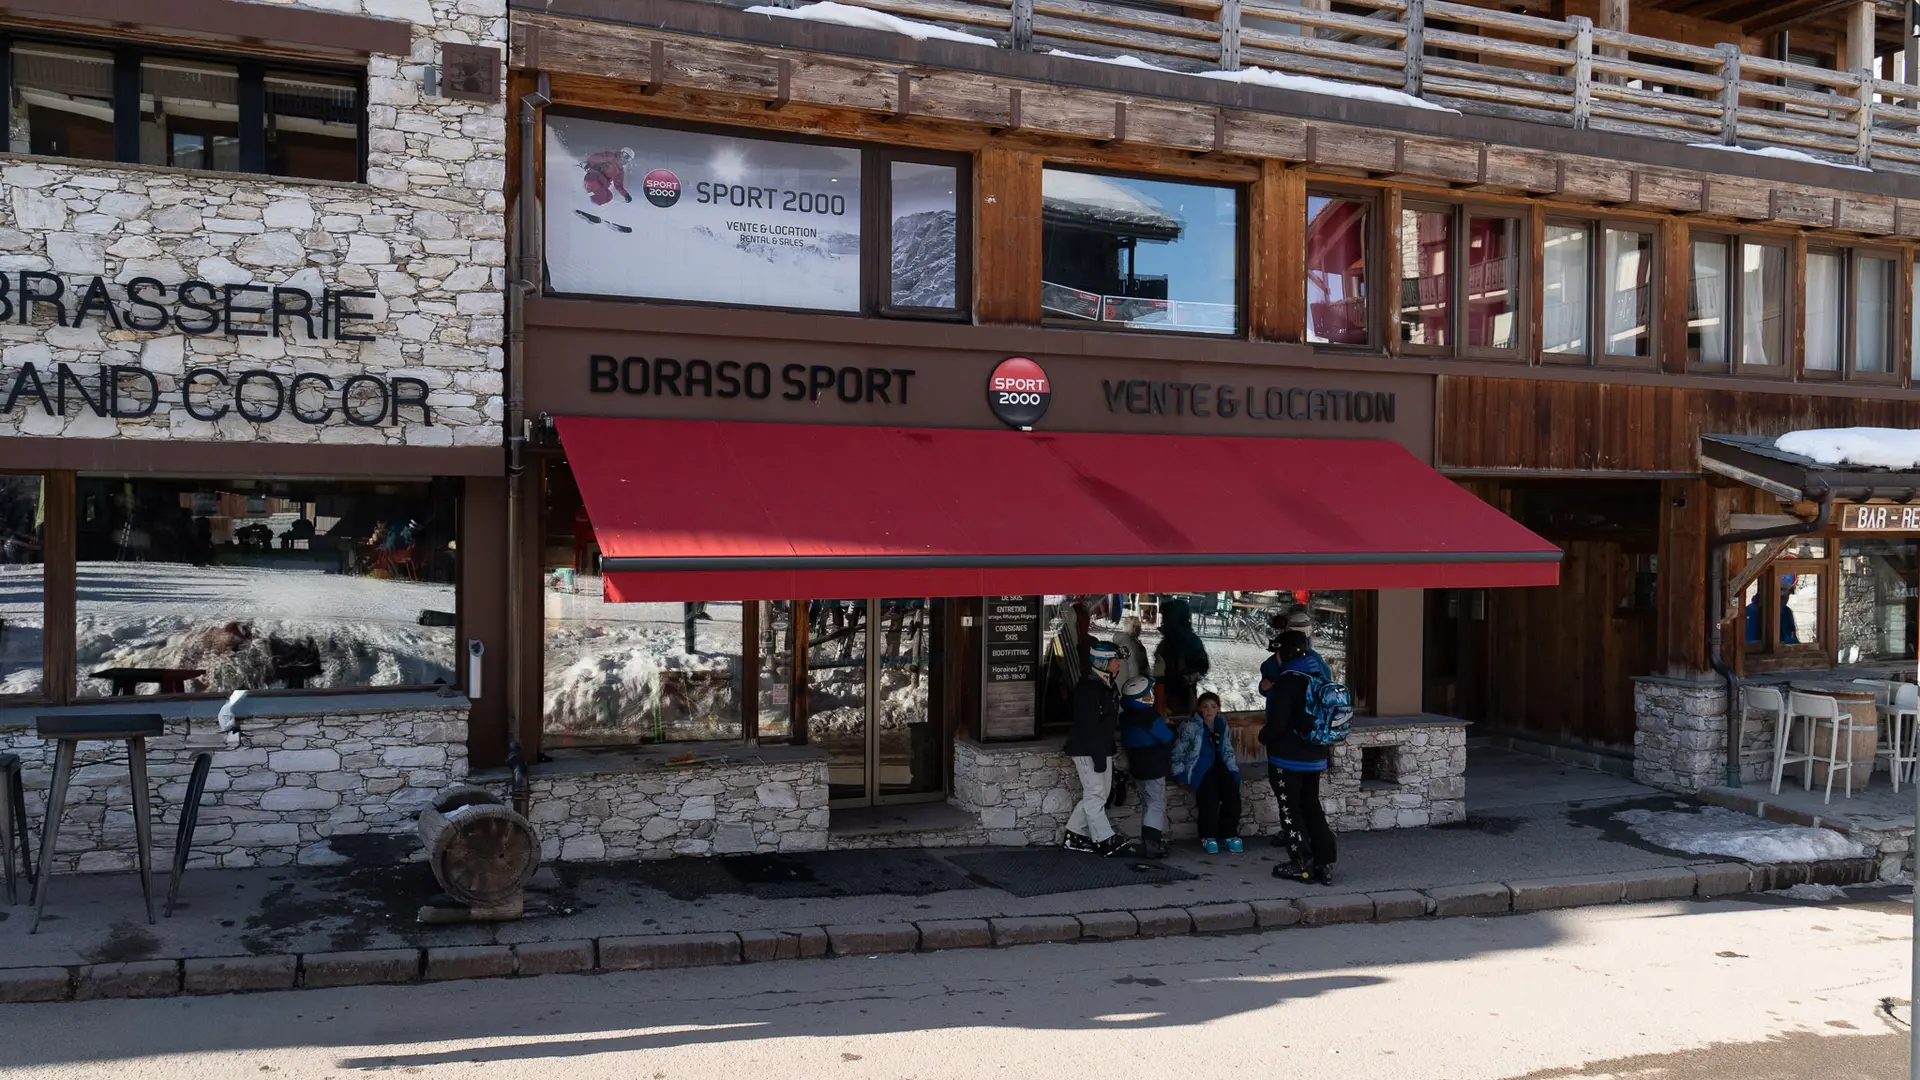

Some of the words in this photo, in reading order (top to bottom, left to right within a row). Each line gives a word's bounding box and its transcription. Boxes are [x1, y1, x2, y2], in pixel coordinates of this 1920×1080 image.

[646, 179, 678, 190] SPORT
[649, 188, 675, 198] 2000
[696, 181, 778, 210] SPORT
[783, 190, 846, 216] 2000
[726, 220, 759, 234] VENTE
[760, 224, 767, 234] &
[768, 224, 817, 238] LOCATION
[740, 234, 772, 245] RENTAL
[779, 238, 804, 247] SALES
[589, 354, 772, 399] BORASO
[781, 363, 916, 405] SPORT
[995, 377, 1045, 391] SPORT
[0, 361, 160, 419] AND
[182, 368, 434, 428] COCOR
[999, 393, 1041, 405] 2000
[1103, 379, 1211, 417] VENTE
[1218, 385, 1237, 418] &
[1247, 386, 1395, 423] LOCATION
[1857, 506, 1887, 529] BAR
[1901, 506, 1920, 529] RE
[996, 605, 1027, 613] ENTRETIEN
[992, 649, 1030, 657] BOOTFITTING
